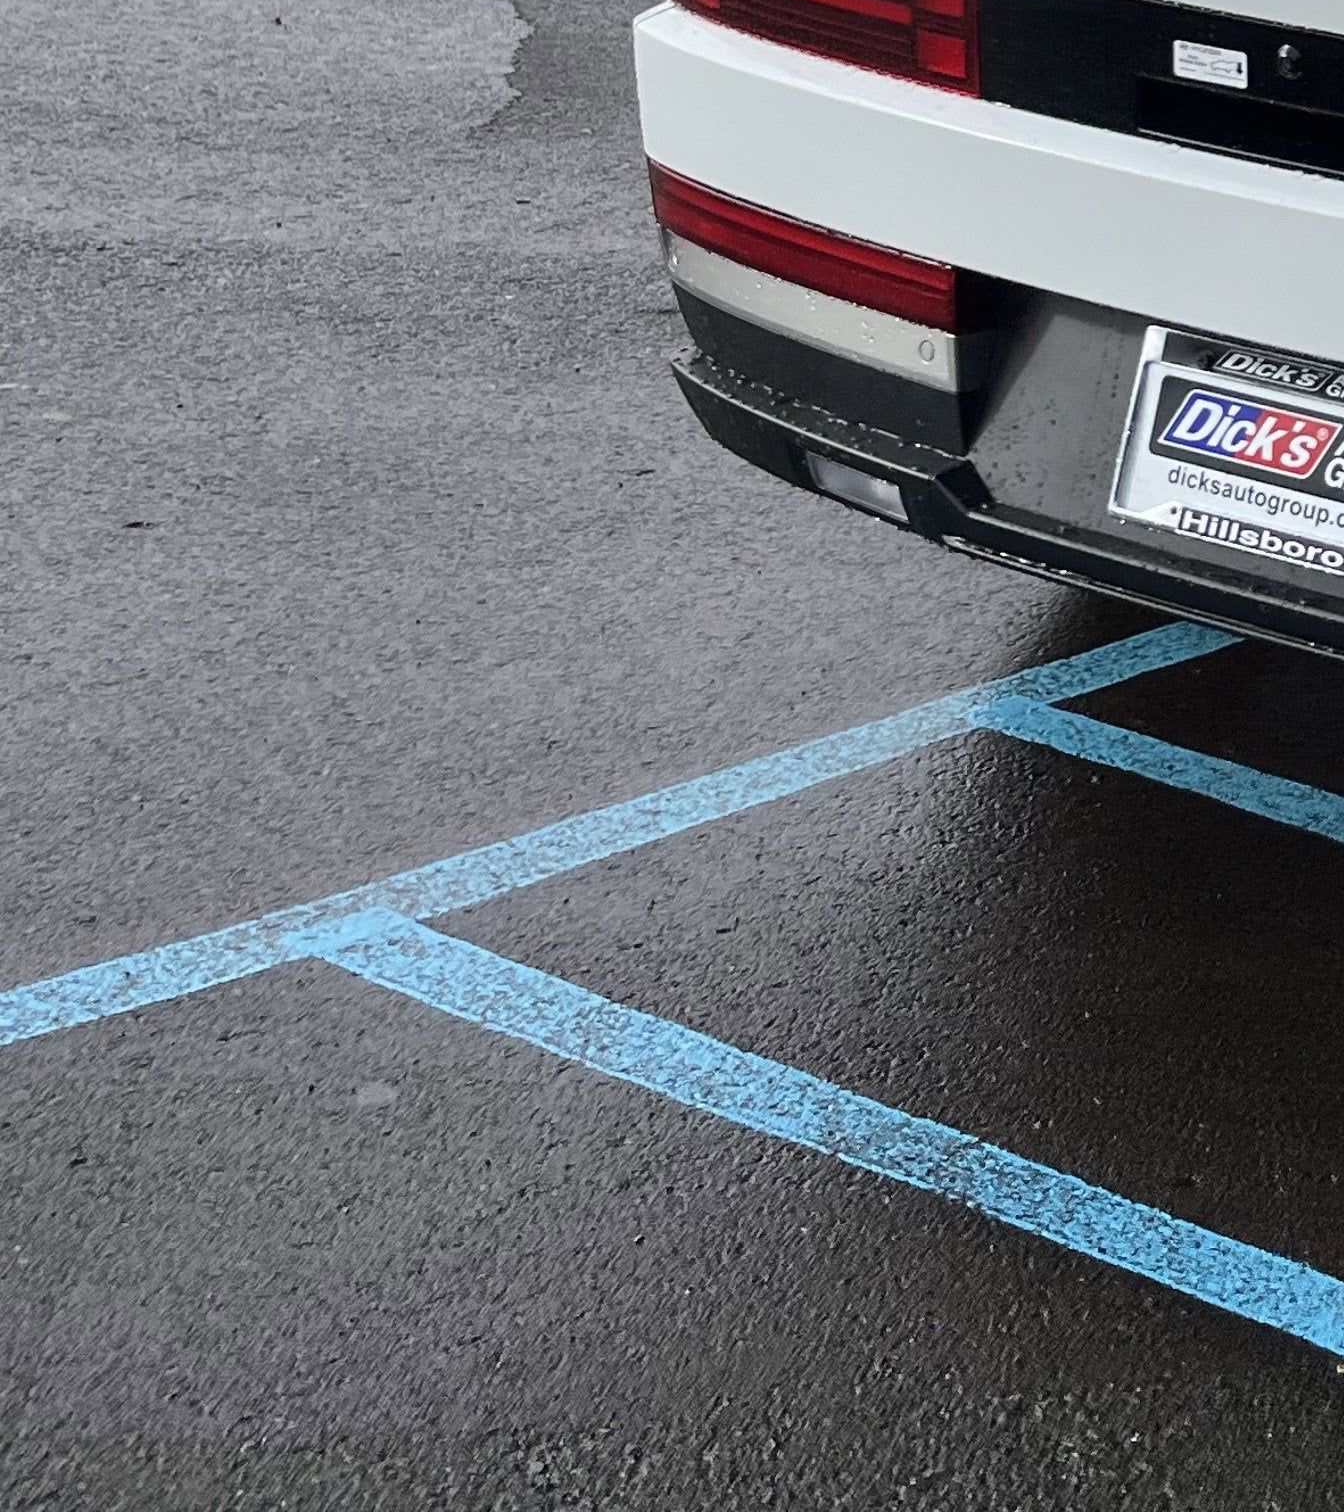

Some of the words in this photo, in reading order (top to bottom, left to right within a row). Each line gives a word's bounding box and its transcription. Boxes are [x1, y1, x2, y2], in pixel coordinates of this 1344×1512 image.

[1221, 352, 1319, 388] Dick's
[1172, 397, 1319, 468] Dick's
[1181, 508, 1344, 567] Hillsboro
